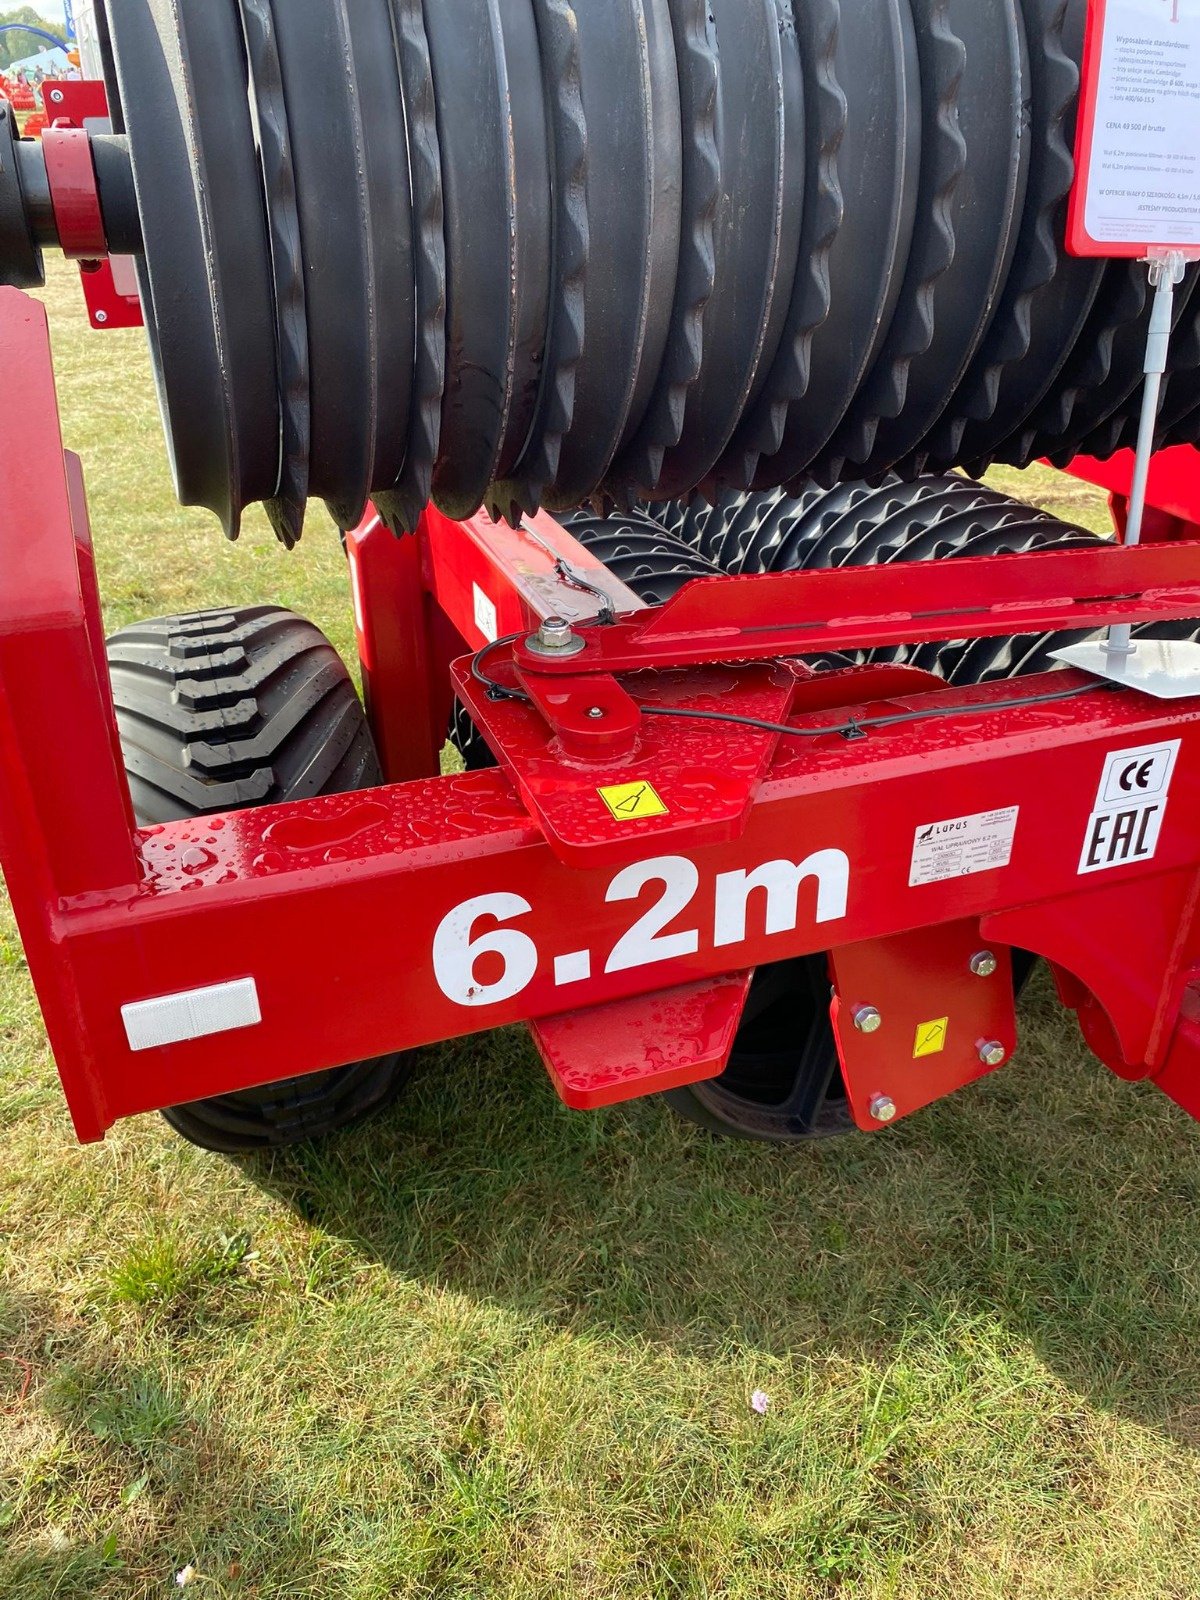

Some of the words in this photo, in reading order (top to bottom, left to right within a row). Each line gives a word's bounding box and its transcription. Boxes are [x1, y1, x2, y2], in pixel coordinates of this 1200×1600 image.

[1131, 123, 1141, 131] 500
[936, 820, 968, 834] LUPUS
[432, 848, 850, 1007] 6.2m
